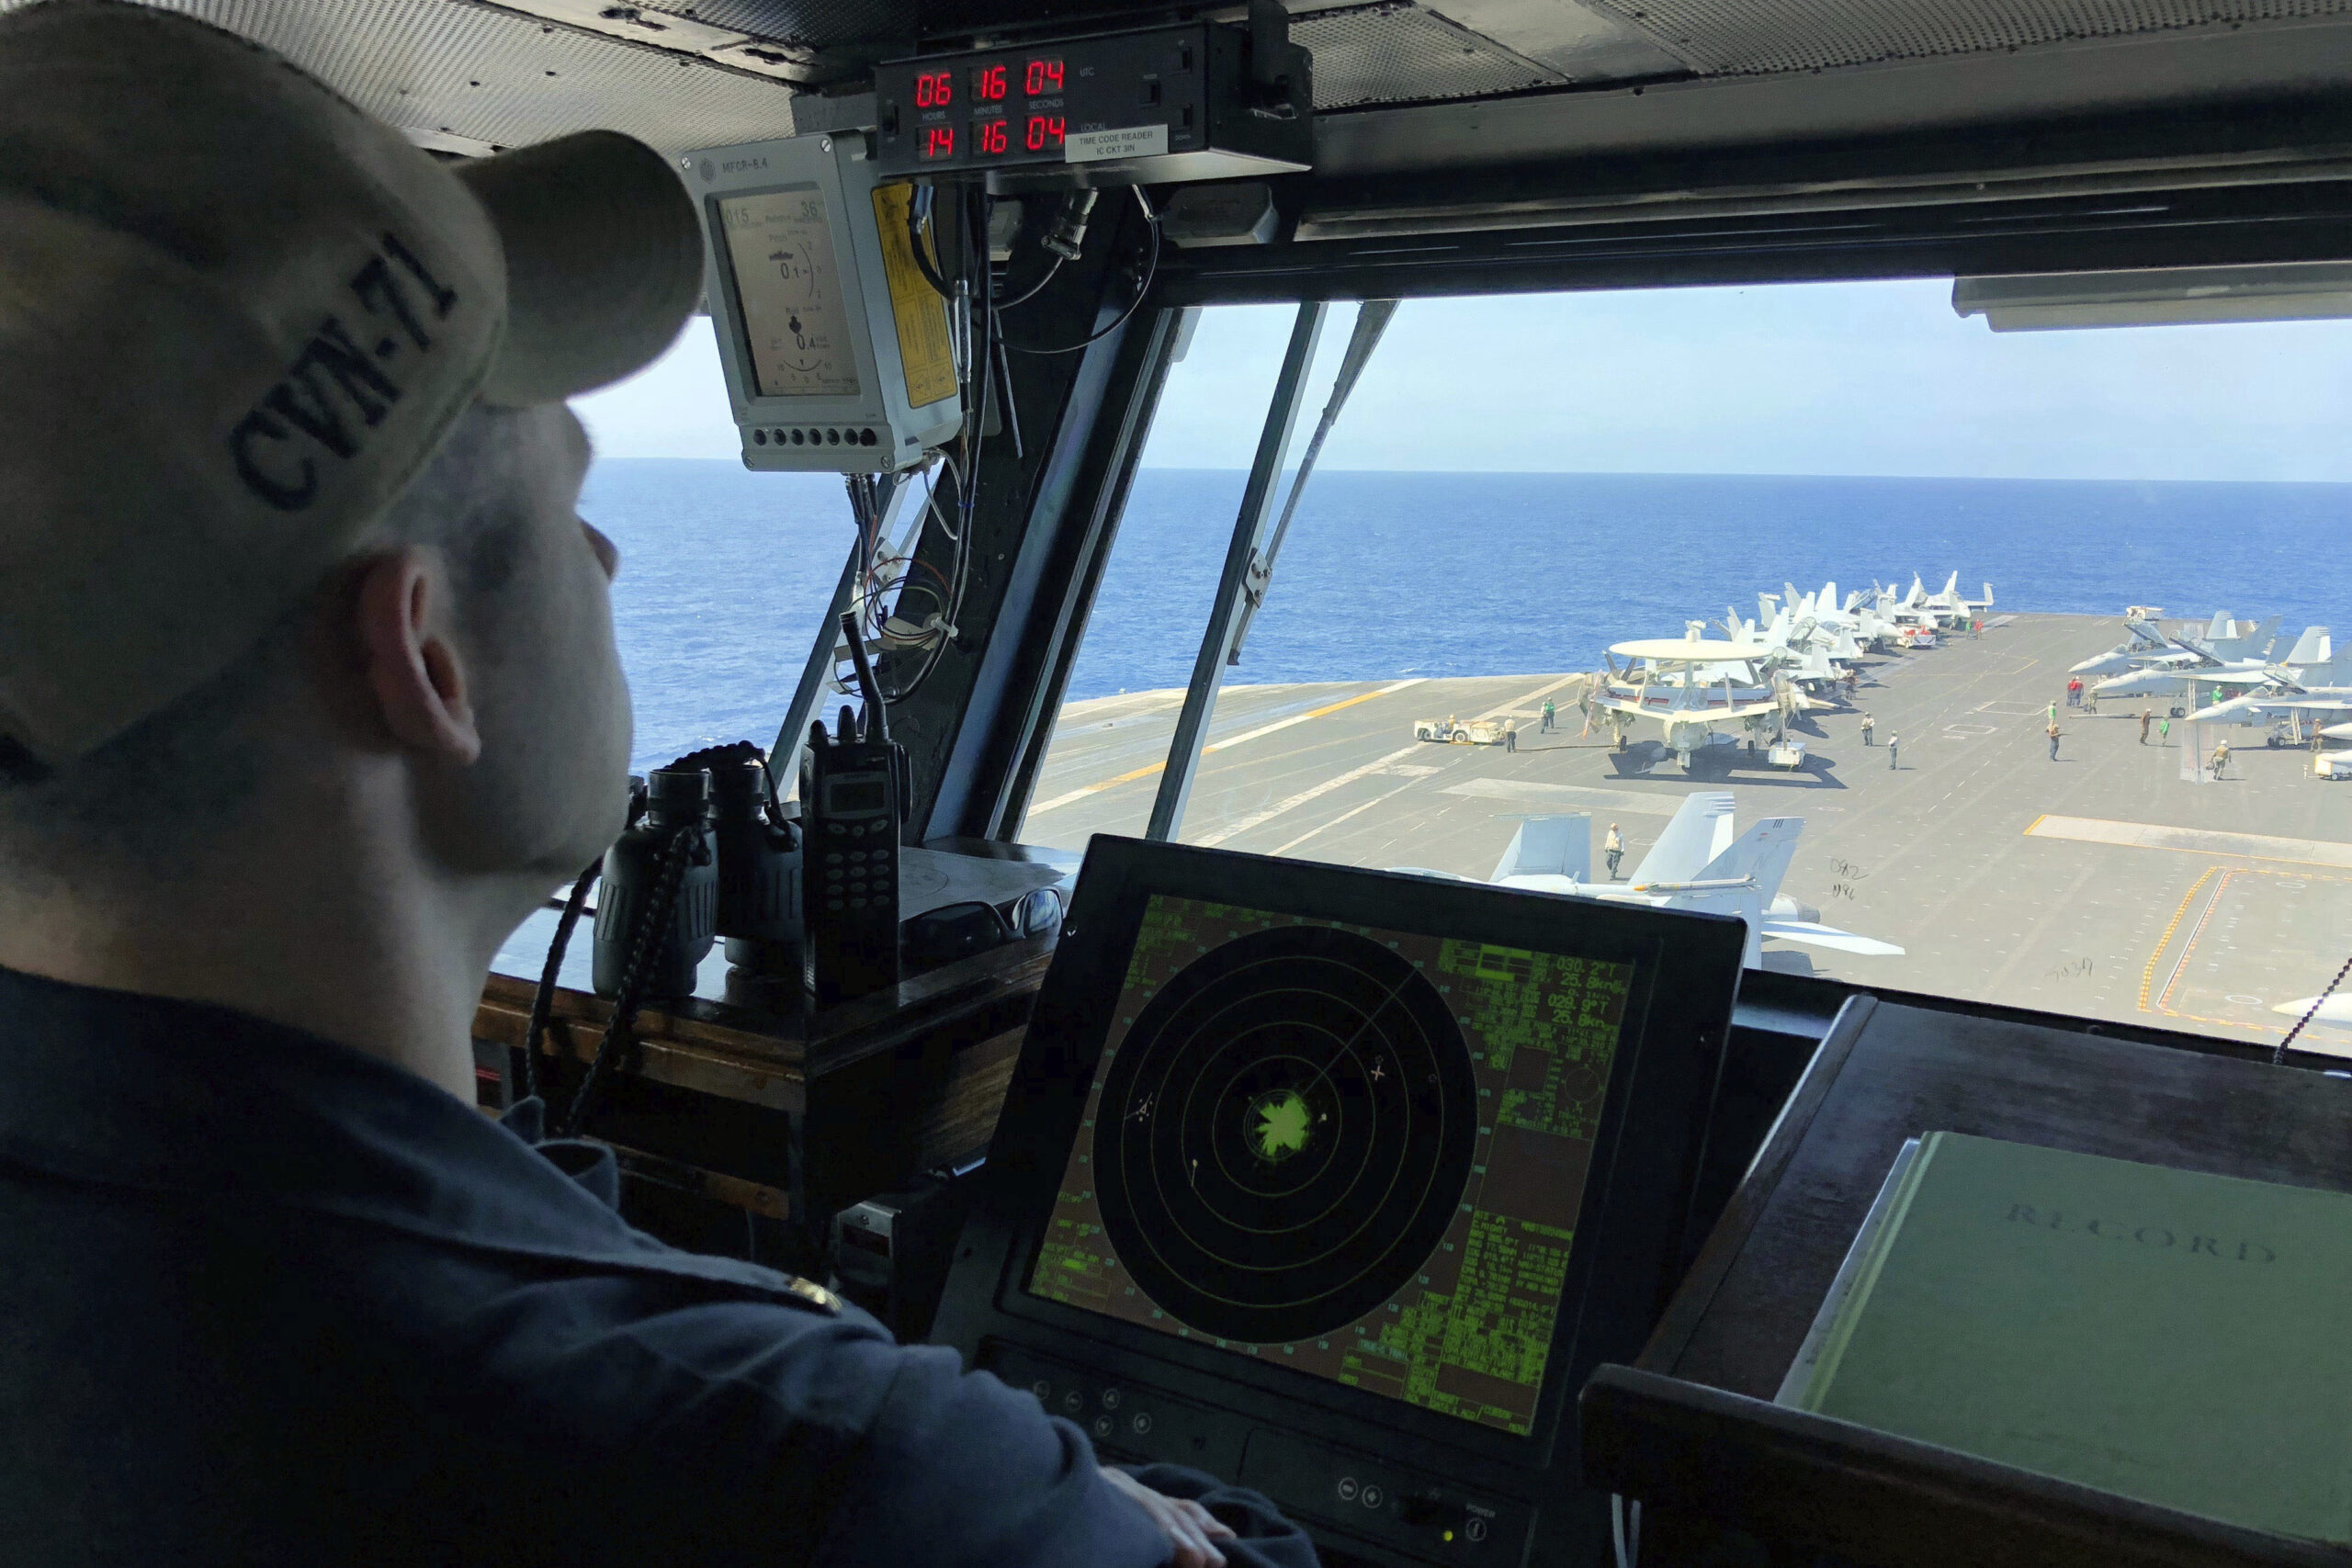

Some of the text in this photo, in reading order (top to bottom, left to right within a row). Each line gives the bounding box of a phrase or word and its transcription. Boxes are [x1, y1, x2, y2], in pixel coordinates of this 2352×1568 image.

[916, 60, 1064, 107] 06 16 04
[1080, 66, 1095, 77] UTC
[922, 98, 1064, 121] HOURS MINUTES SECONDS
[928, 116, 1066, 157] 14 16 04
[1079, 130, 1153, 146] TIME CODE READER
[1096, 147, 1104, 155] IC
[1105, 145, 1122, 154] CKT
[230, 231, 458, 512] CVN-71
[2007, 1202, 2278, 1264] RECORD
